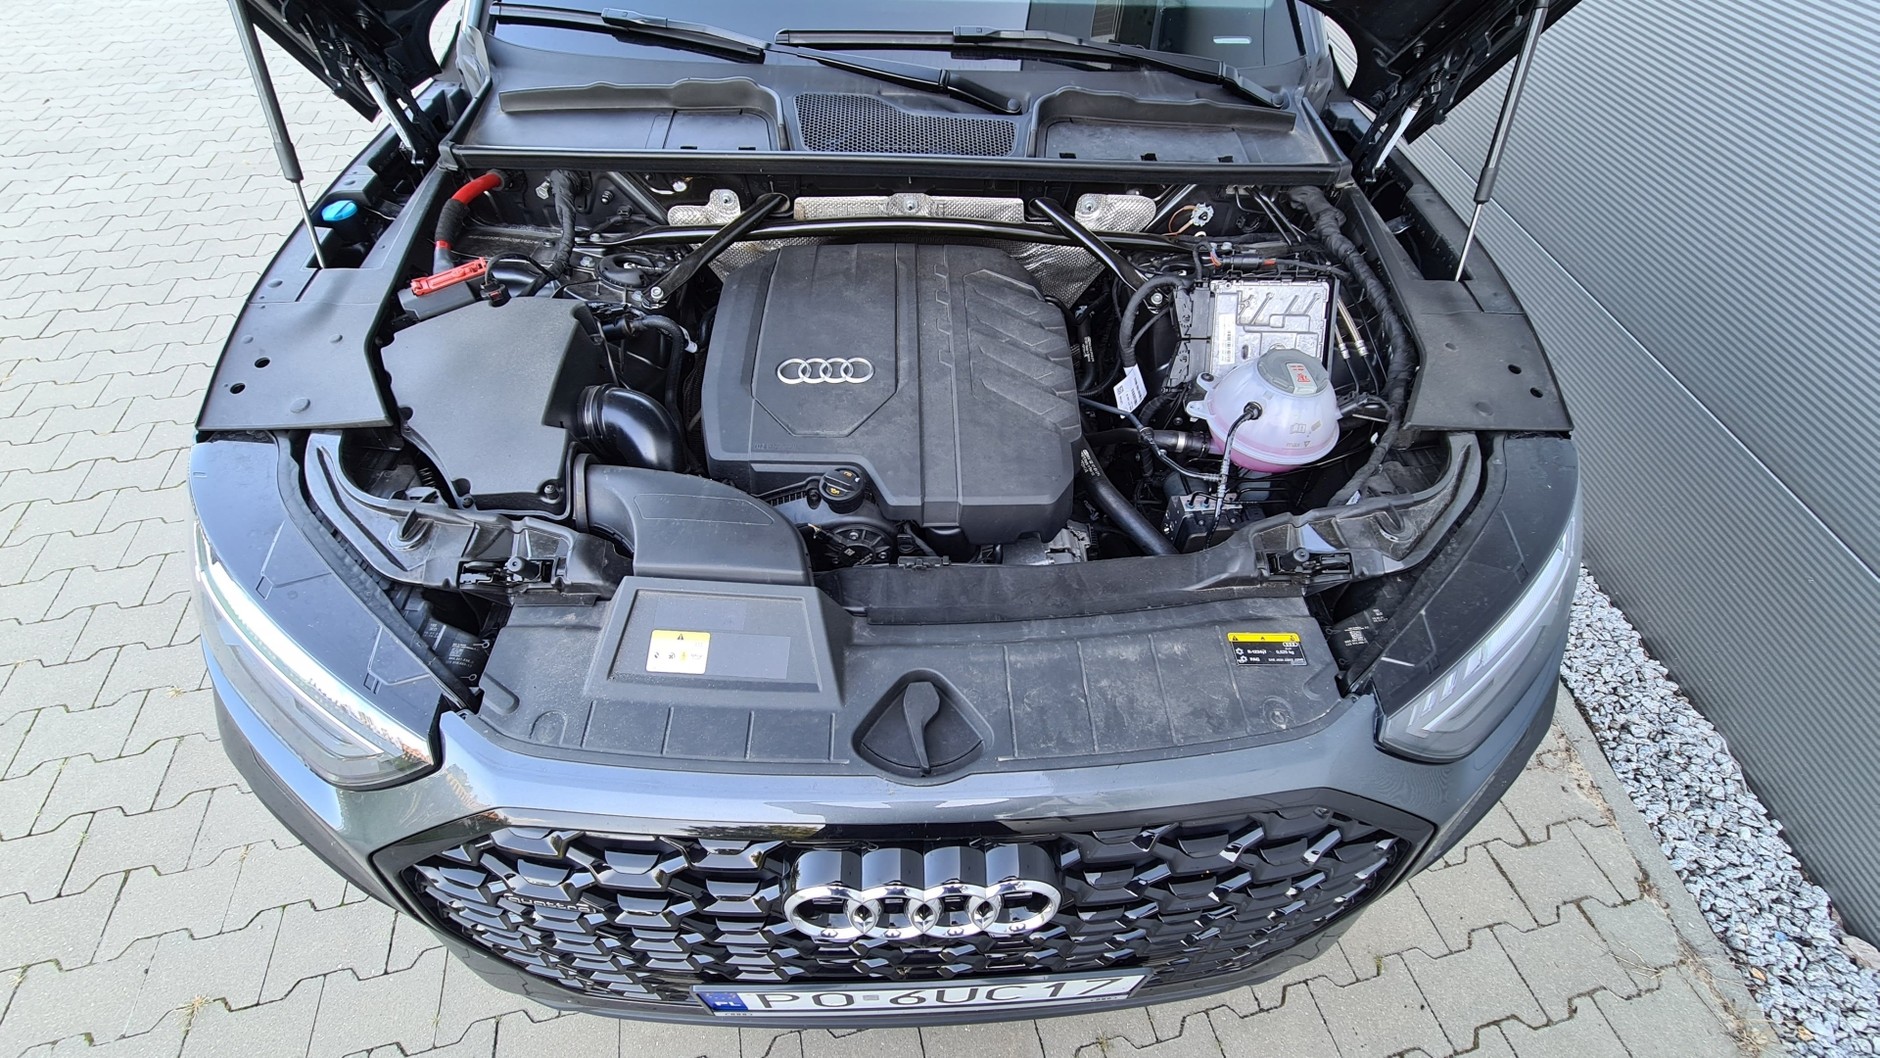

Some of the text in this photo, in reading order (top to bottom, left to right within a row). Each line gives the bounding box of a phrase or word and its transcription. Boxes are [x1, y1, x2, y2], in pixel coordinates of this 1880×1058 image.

[503, 893, 594, 914] quattro
[756, 978, 1124, 1008] PO 6UC17
